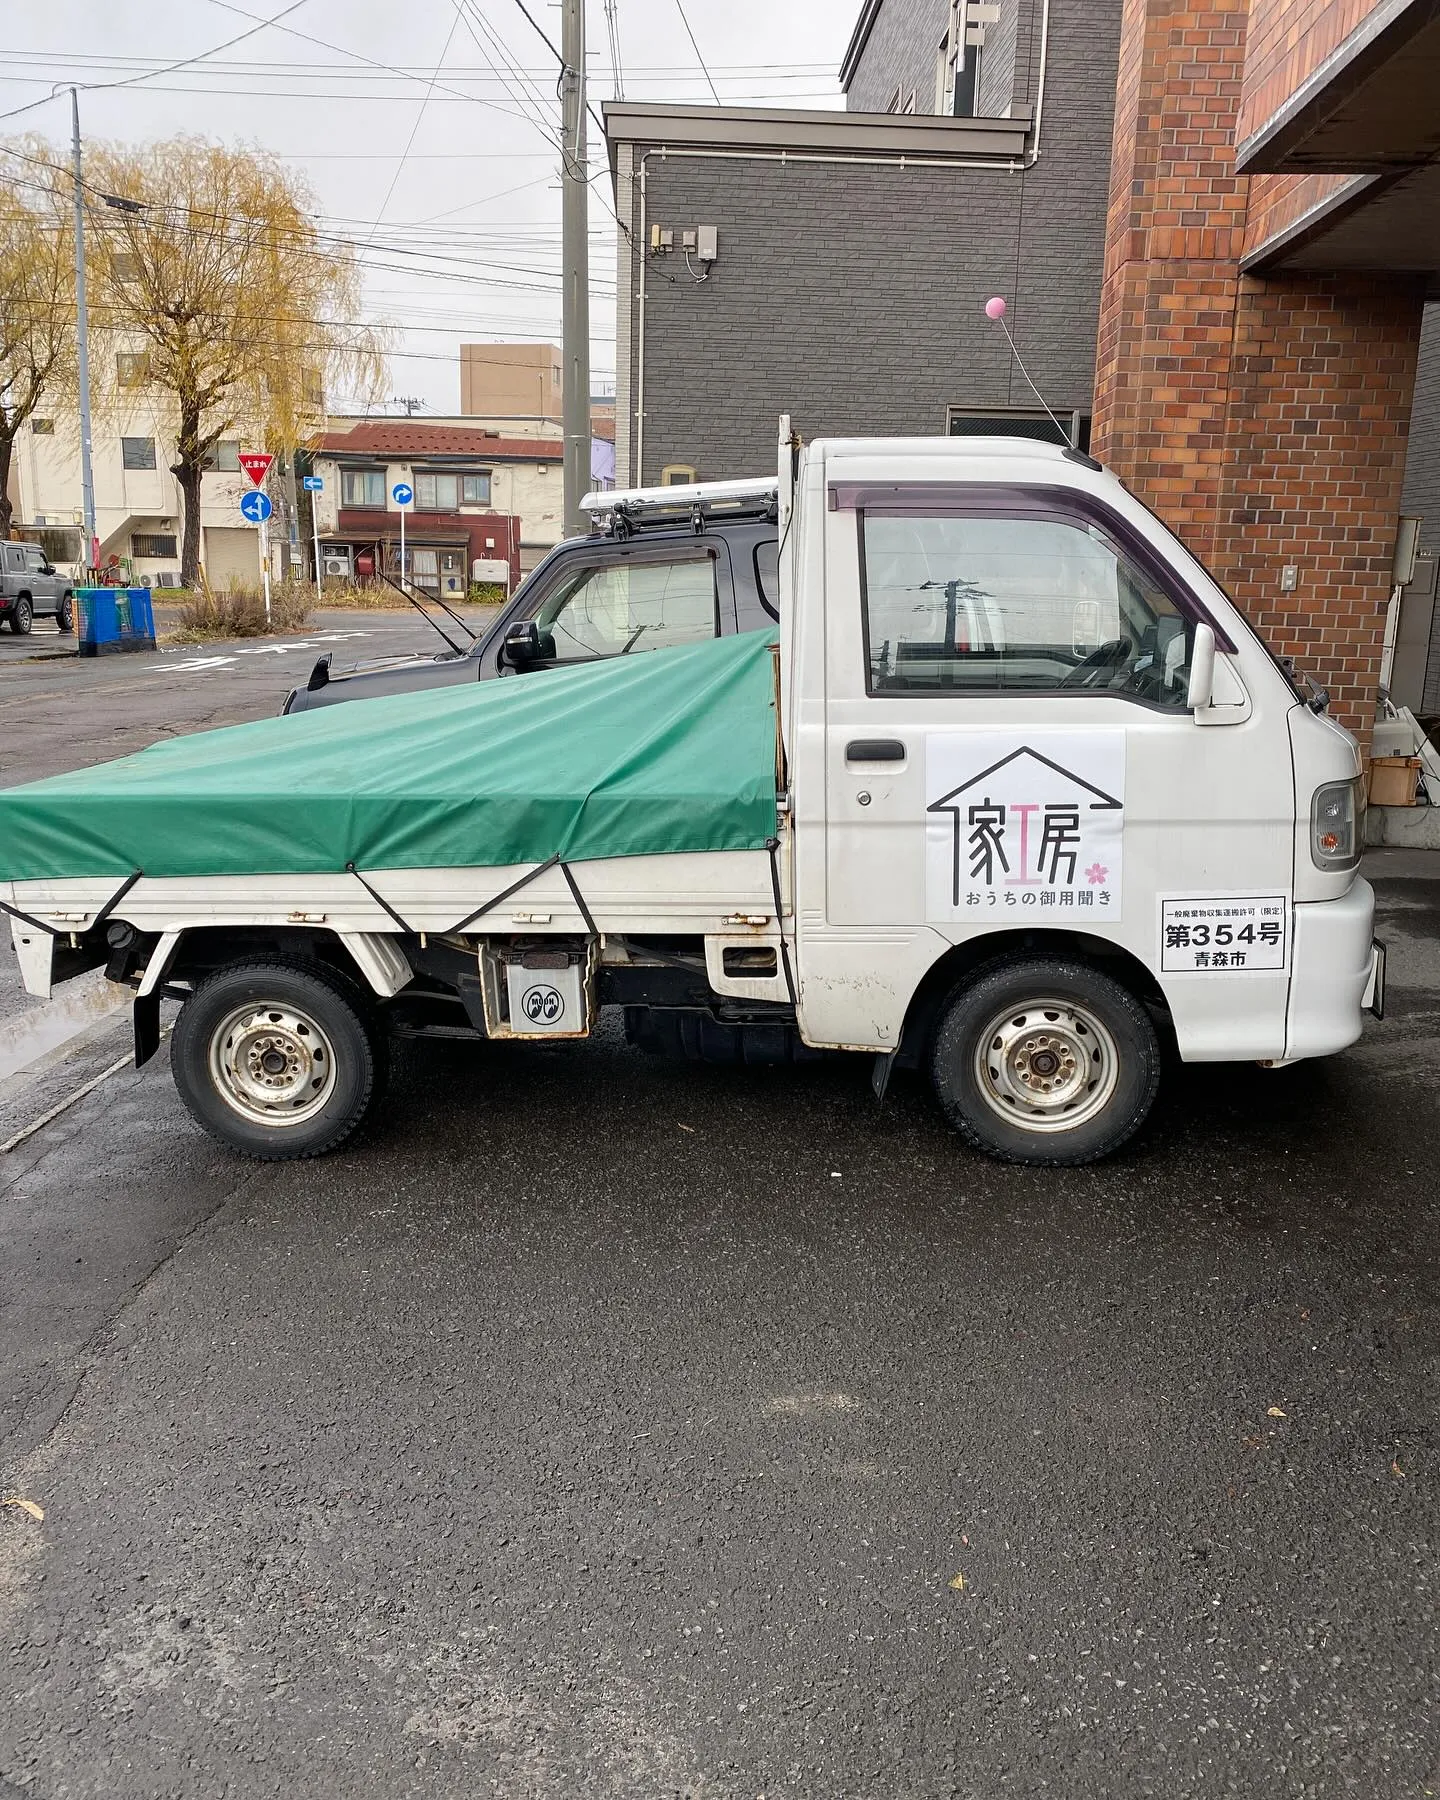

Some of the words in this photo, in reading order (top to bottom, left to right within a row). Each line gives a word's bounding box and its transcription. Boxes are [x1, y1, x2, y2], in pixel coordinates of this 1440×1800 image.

[245, 460, 268, 469] 止まれ
[968, 797, 1081, 886] 家工房
[966, 890, 1112, 906] おうちの御用聞き
[1165, 922, 1283, 948] 第354号
[1194, 950, 1247, 967] 青森市
